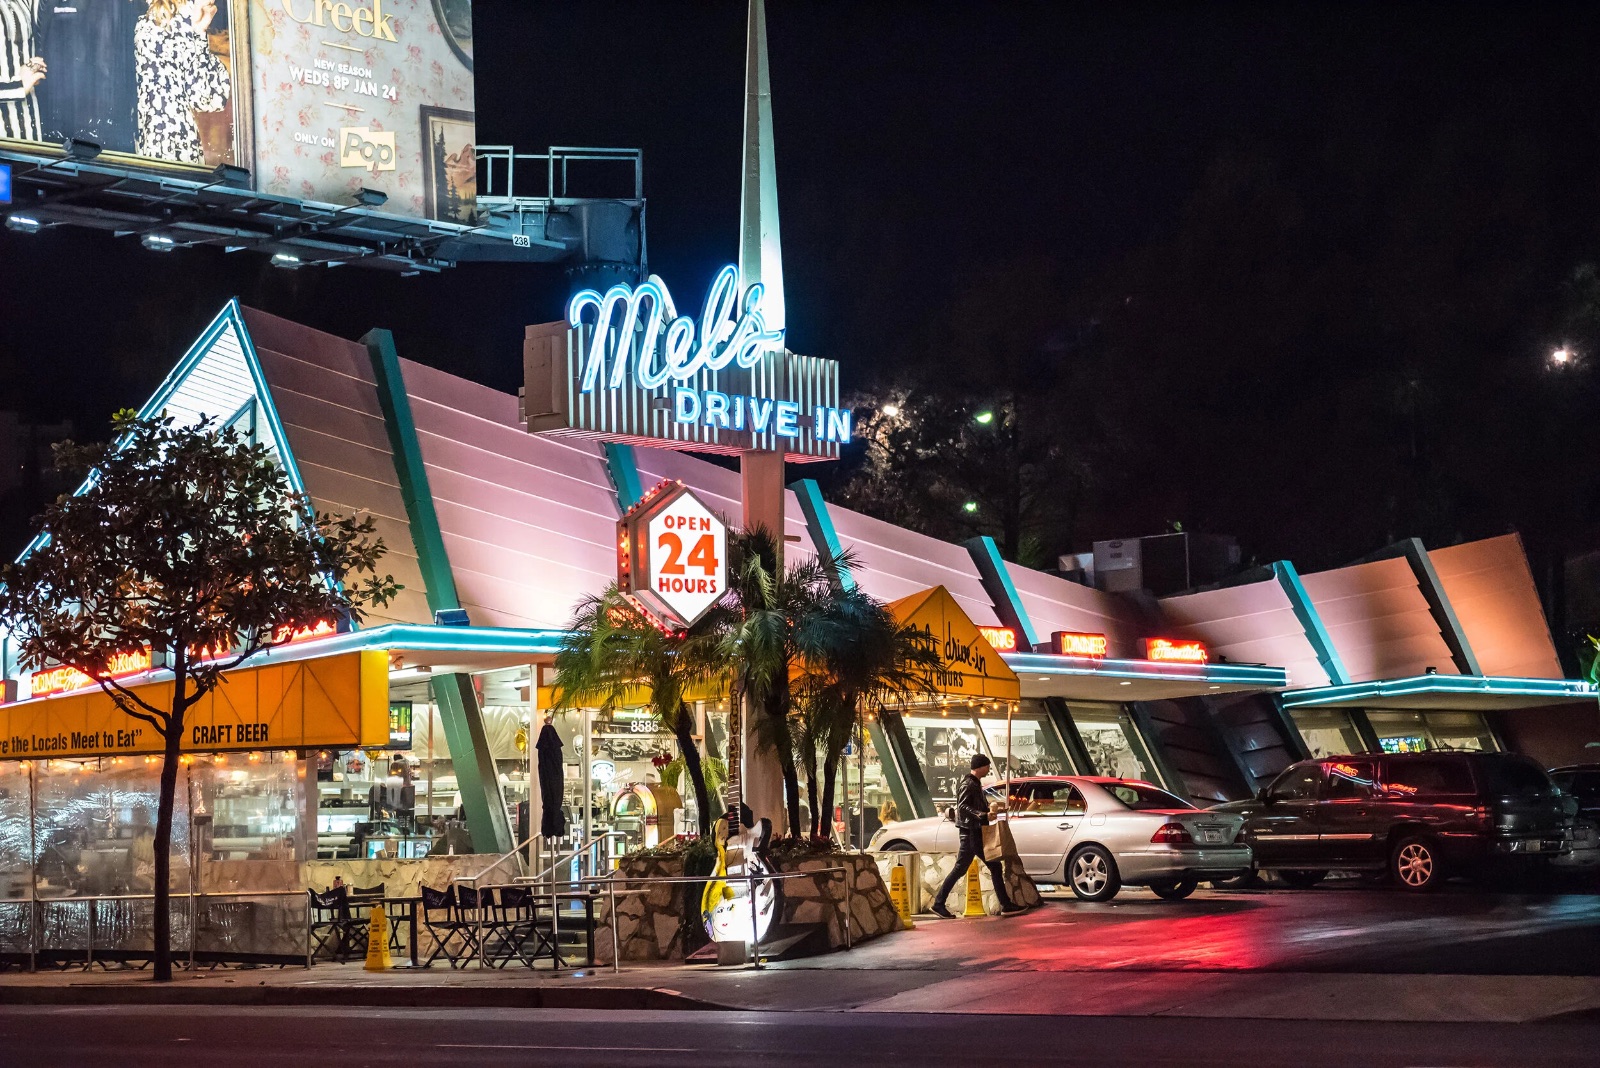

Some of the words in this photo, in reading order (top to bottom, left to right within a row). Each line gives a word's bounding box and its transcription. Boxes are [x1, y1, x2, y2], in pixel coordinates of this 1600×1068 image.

[314, 59, 335, 71] NEW
[337, 63, 372, 79] SEASON
[289, 66, 330, 87] WEDS
[333, 77, 350, 91] 8P
[353, 79, 378, 97] JAN
[381, 84, 397, 100] 24
[294, 132, 318, 146] ONLY
[321, 136, 335, 148] ON
[343, 132, 393, 170] Pop
[513, 236, 529, 247] 238
[676, 386, 799, 437] DRIVE
[815, 406, 851, 444] IN
[664, 515, 711, 531] OPEN
[658, 532, 718, 576] 24
[658, 577, 717, 594] HOURS
[945, 621, 988, 677] drive-in
[1064, 635, 1106, 654] DINNER
[937, 671, 964, 687] HOURS
[192, 724, 232, 744] CRAFT
[237, 723, 269, 743] BEER
[631, 720, 658, 733] 8585
[12, 736, 29, 753] the
[32, 734, 68, 752] Locals
[71, 732, 100, 748] Meet
[103, 733, 114, 748] to
